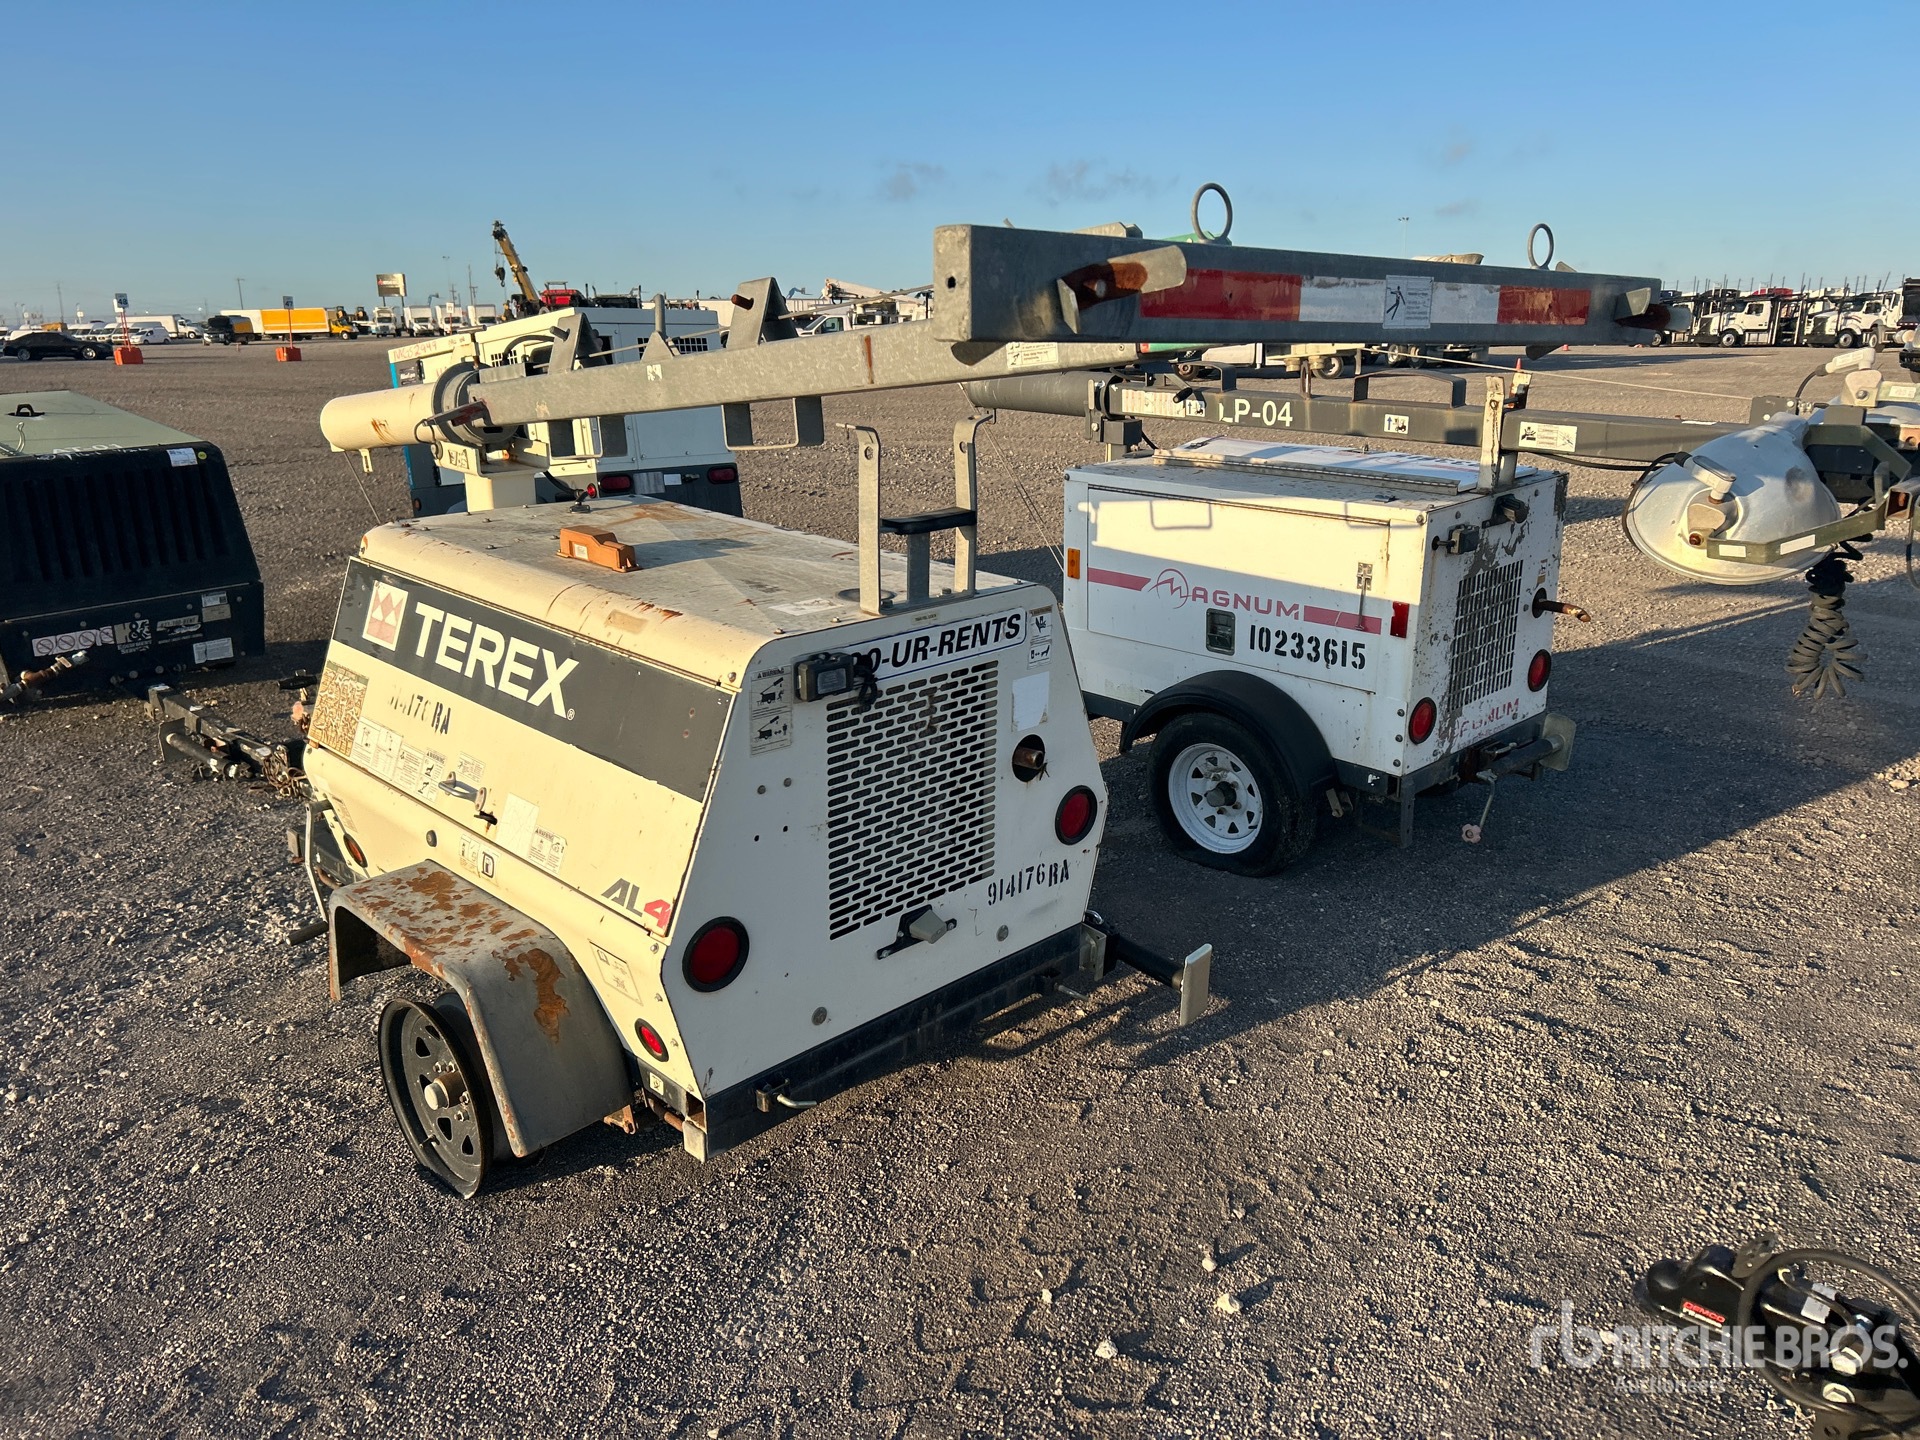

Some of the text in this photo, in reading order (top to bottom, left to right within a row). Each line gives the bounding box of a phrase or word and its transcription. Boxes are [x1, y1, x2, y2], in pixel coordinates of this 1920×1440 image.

[1218, 398, 1293, 427] LP-04
[1148, 568, 1299, 620] MAGNUM
[414, 601, 580, 719] TEREX
[1249, 624, 1366, 670] 10233615
[601, 878, 671, 928] AL4
[987, 858, 1069, 906] 914176RA
